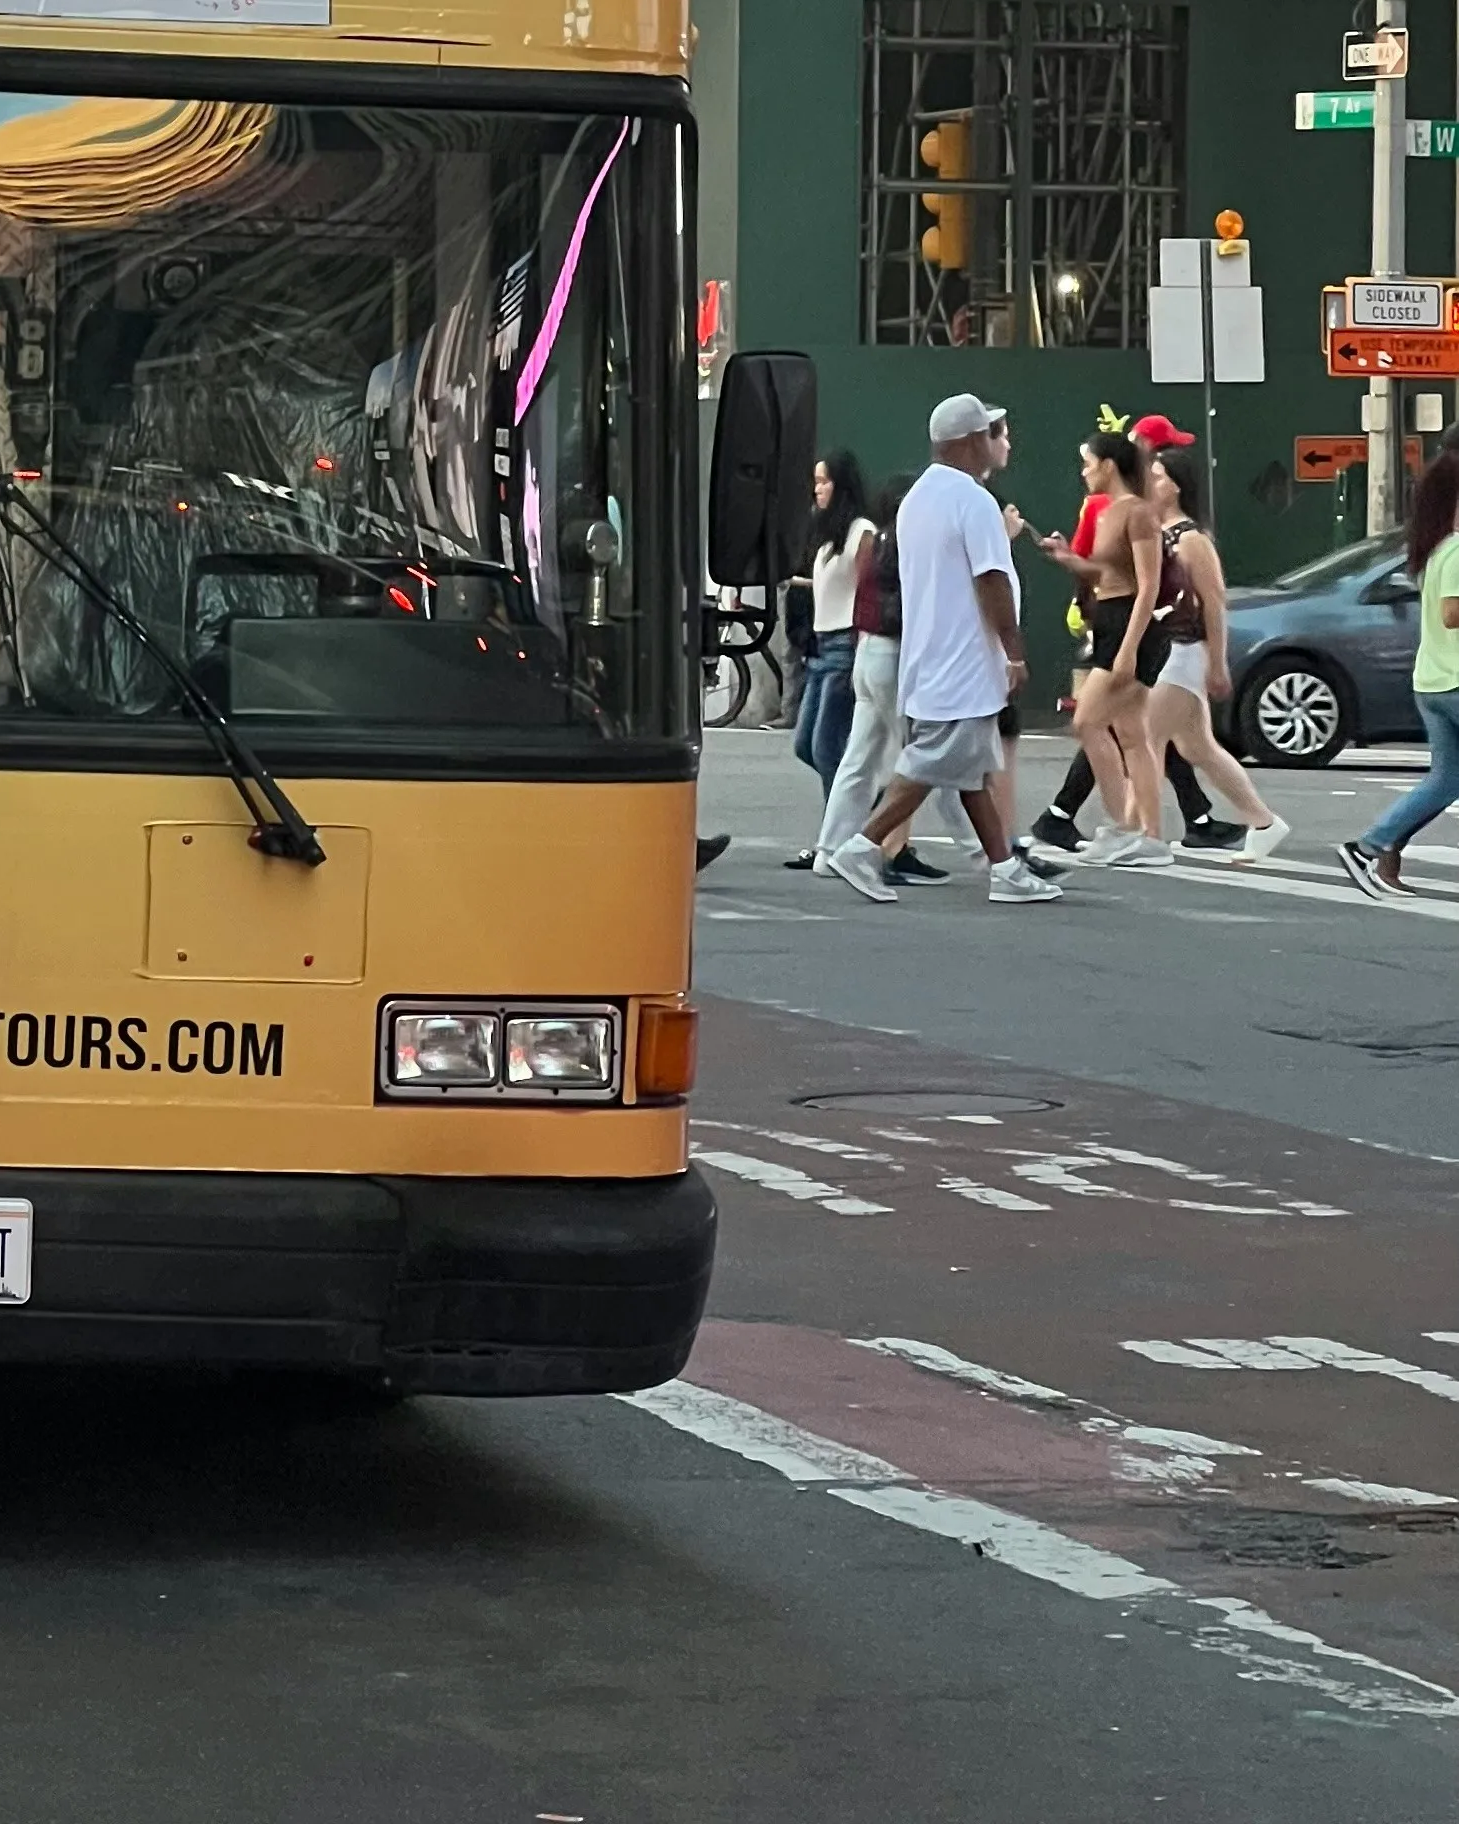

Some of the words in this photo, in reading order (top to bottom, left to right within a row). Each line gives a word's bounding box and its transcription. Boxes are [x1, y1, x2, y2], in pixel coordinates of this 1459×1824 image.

[1352, 47, 1370, 64] ONE
[1330, 98, 1339, 124] 7
[1436, 127, 1456, 153] W
[1365, 289, 1427, 304] SIDEWALK
[1372, 306, 1421, 320] CLOSED
[1360, 338, 1384, 351] USE
[1382, 354, 1441, 369] ALKWAY
